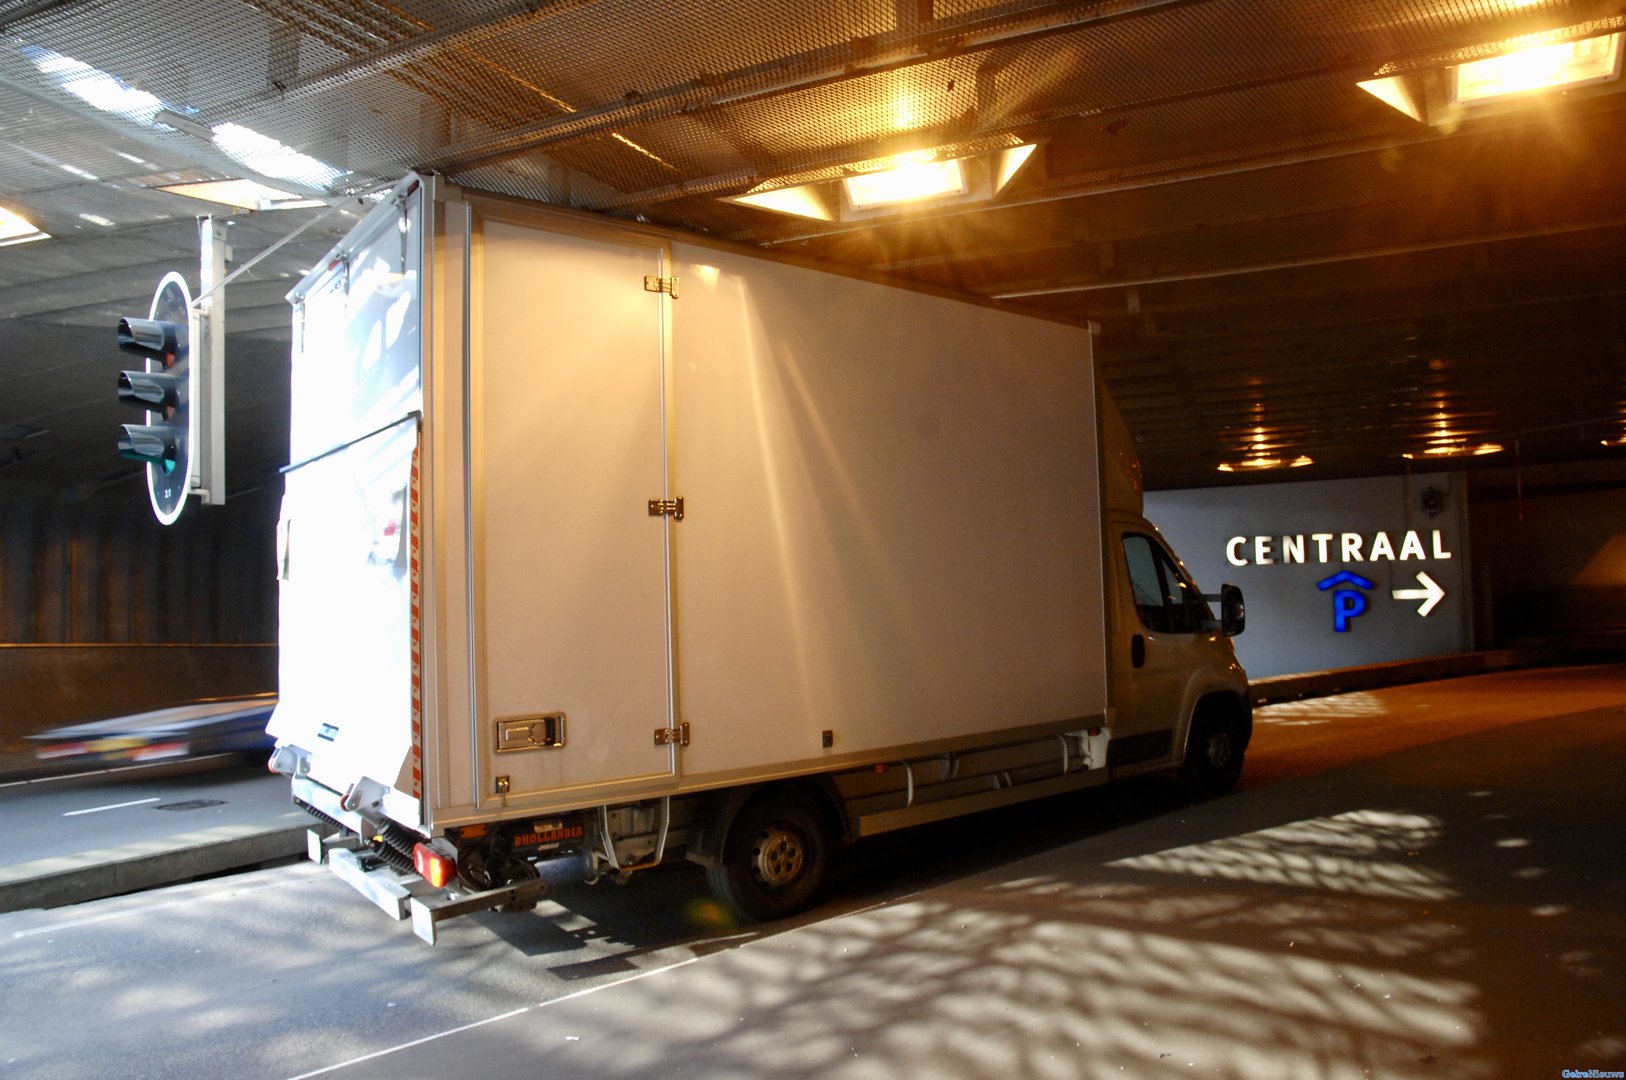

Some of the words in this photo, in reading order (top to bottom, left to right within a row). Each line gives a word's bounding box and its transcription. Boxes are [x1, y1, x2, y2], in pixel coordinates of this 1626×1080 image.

[1226, 529, 1452, 567] CENTRAAL
[1333, 590, 1366, 632] P
[513, 826, 583, 847] DHOLLANDIA
